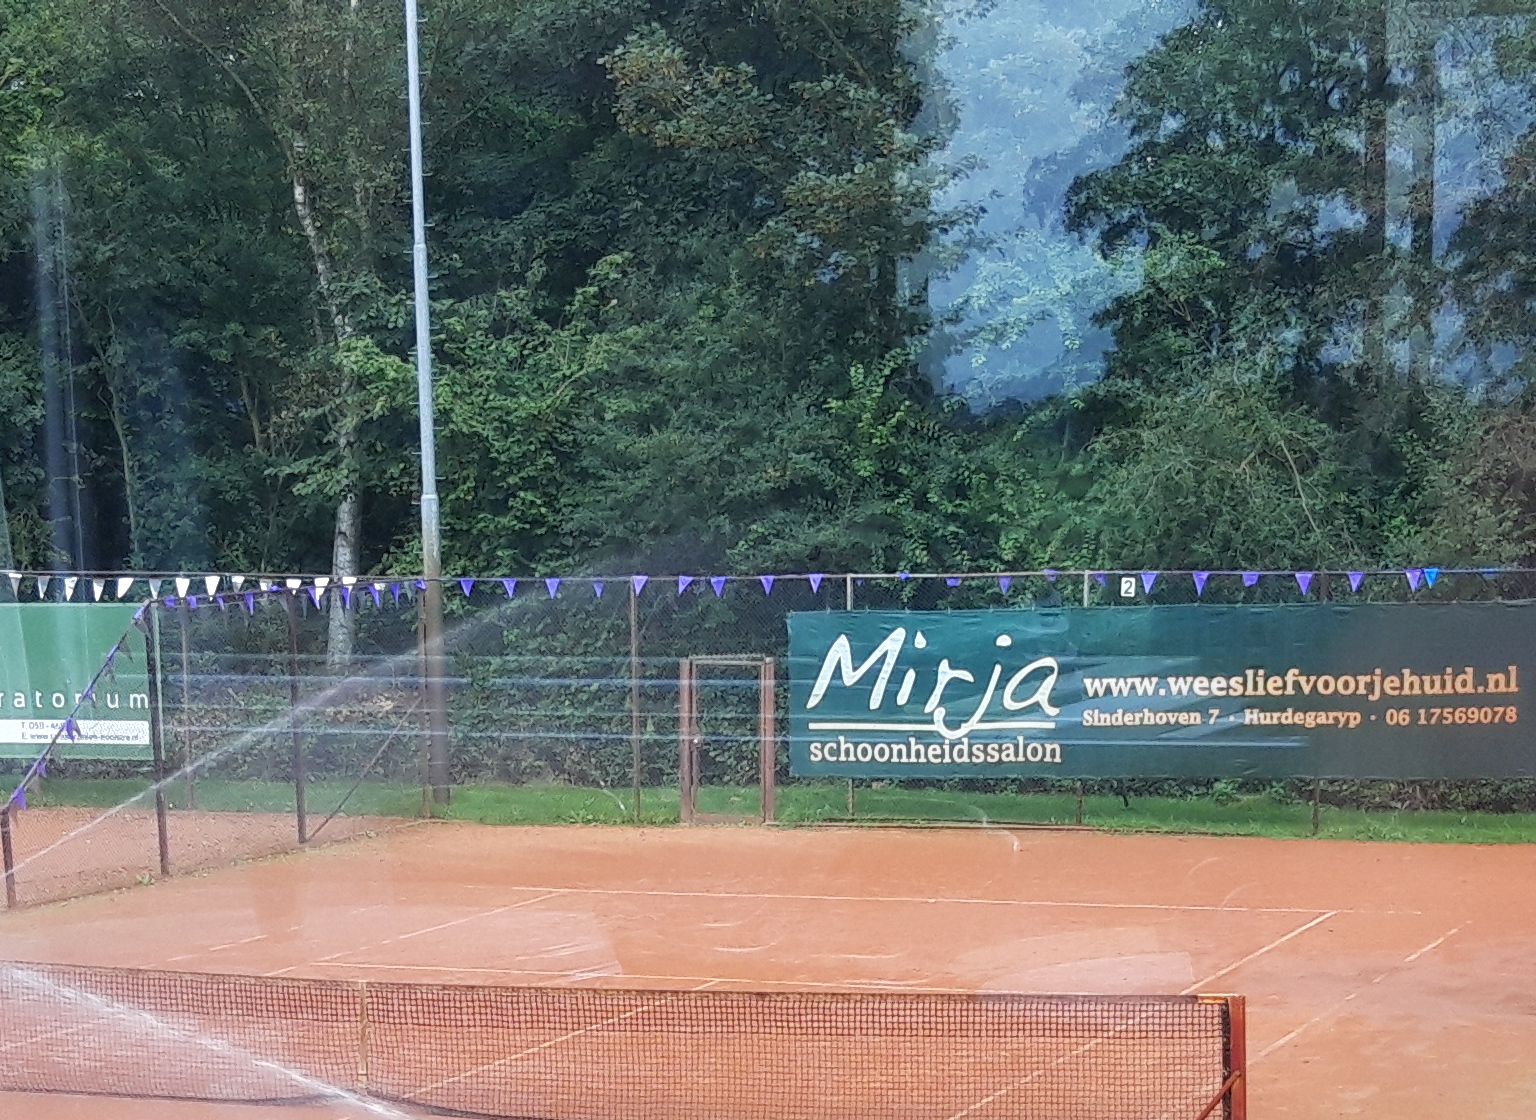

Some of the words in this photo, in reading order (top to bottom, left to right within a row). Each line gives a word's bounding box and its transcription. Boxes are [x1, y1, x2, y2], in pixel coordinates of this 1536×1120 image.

[805, 627, 1061, 739] Mirja
[1082, 667, 1519, 701] www.weesliefvoorjehuid.nl
[1082, 708, 1202, 727] Sinderhoven
[1208, 708, 1219, 726] 7
[1243, 709, 1362, 729] Hurdegaryp
[1385, 709, 1411, 726] 06
[1416, 705, 1518, 725] 17569078
[809, 736, 1063, 764] schoonheidssalon
